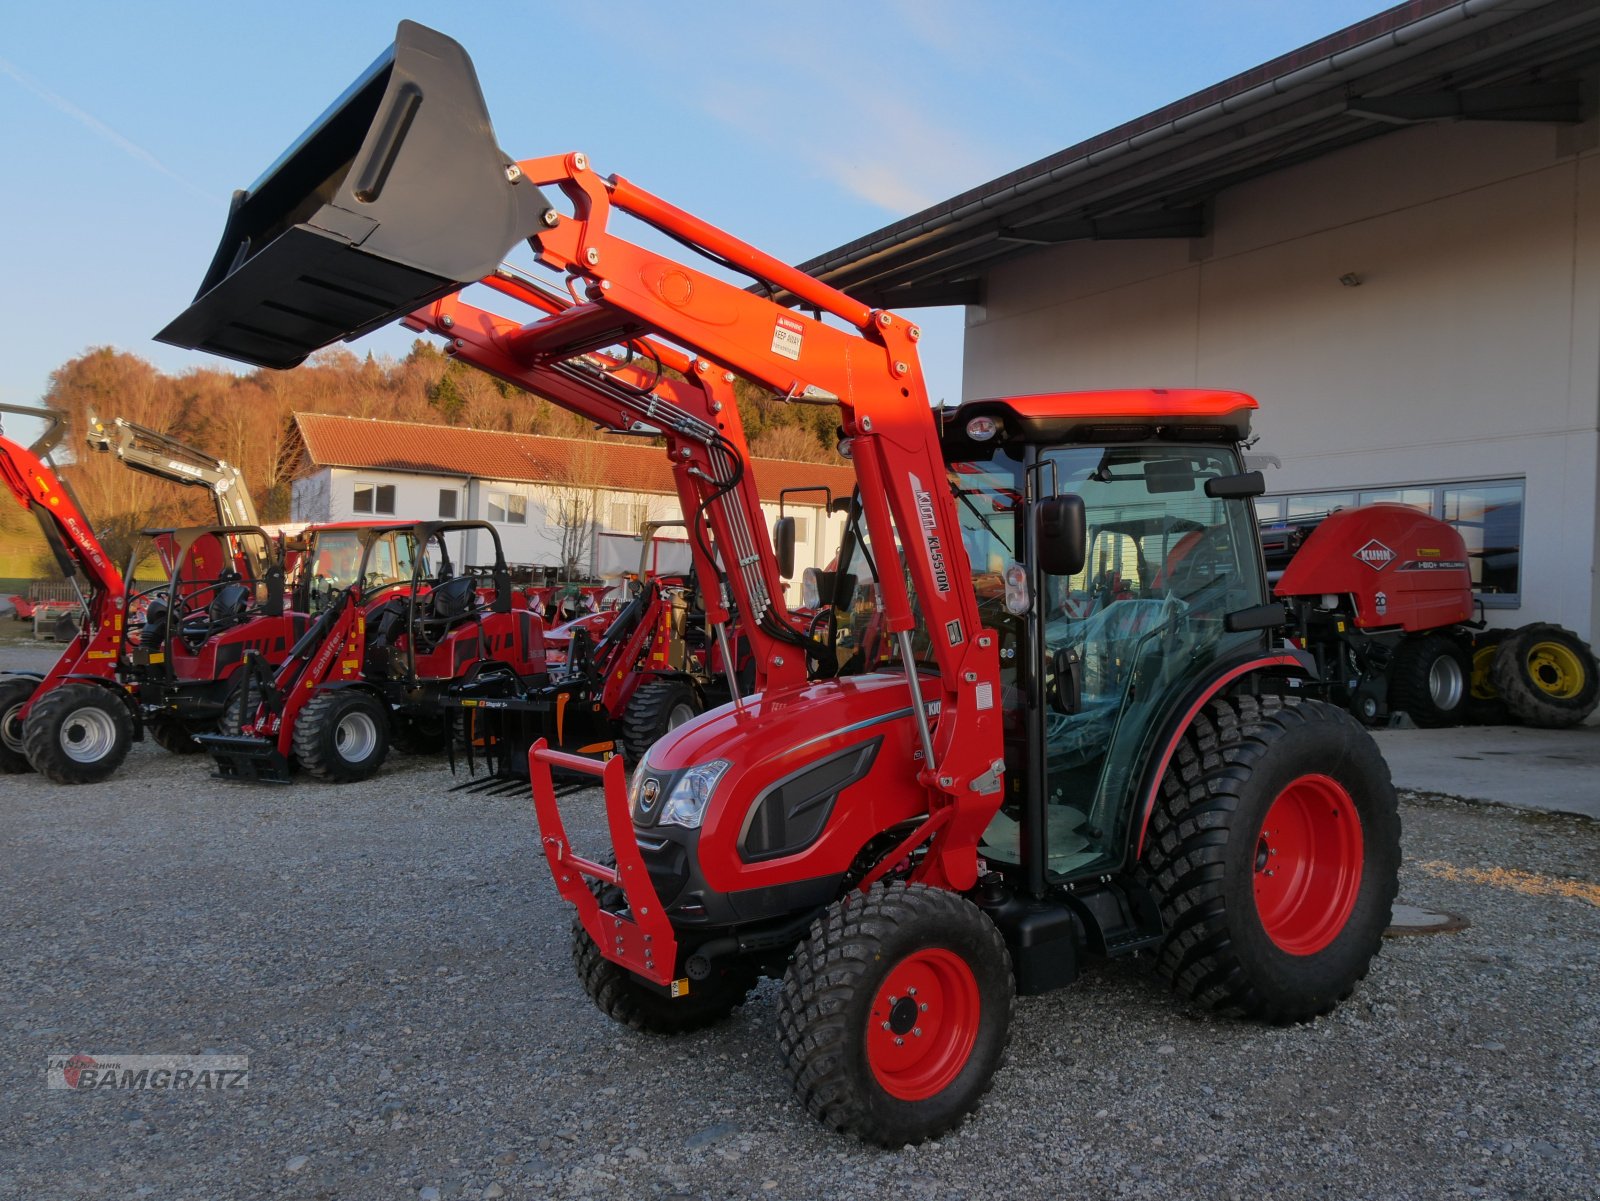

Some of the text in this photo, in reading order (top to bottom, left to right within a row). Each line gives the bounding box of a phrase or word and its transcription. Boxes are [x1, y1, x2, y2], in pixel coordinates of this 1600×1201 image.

[775, 329, 787, 341] KEEP
[1360, 548, 1391, 561] KUHN
[927, 535, 951, 593] KL5510N
[928, 701, 942, 716] KIO
